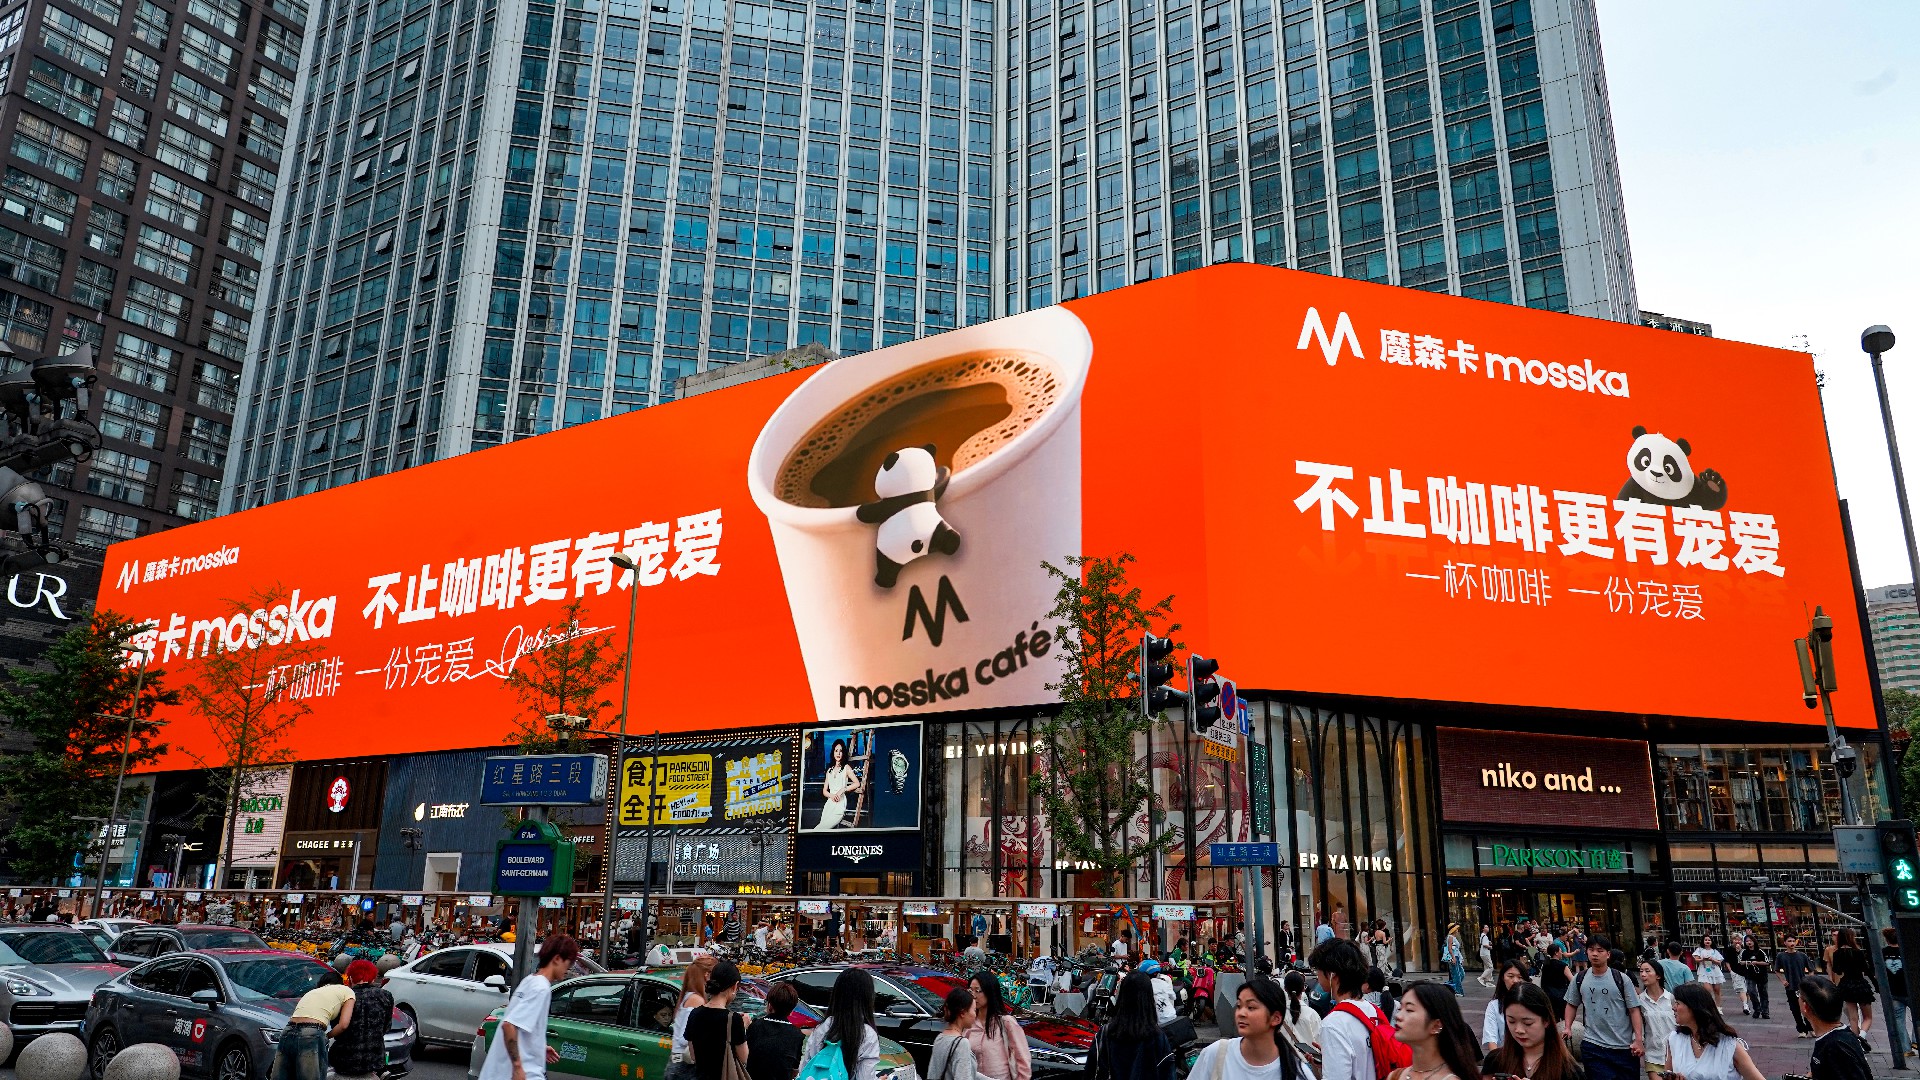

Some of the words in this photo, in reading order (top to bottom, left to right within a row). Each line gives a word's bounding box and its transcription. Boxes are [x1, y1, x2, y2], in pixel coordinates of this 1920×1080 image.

[1380, 328, 1479, 375] 魔森卡
[1485, 351, 1630, 398] mosska
[1293, 460, 1786, 577] 不止咖啡更有宠爱
[143, 556, 181, 583] 魔森卡
[180, 545, 240, 576] mosska
[362, 508, 723, 629] 不止咖啡更有宠爱
[7, 572, 72, 620] UR
[1405, 559, 1552, 607] 一杯咖啡
[1568, 576, 1706, 621] 一份宠爱
[186, 588, 337, 660] mosska
[241, 655, 344, 703] 一杯咖啡
[355, 636, 476, 690] 一份宠爱
[839, 667, 970, 710] mosska
[975, 620, 1052, 686] café
[493, 762, 581, 785] 红星路三段
[627, 761, 668, 788] 食力
[669, 761, 710, 773] PARKSON
[687, 773, 709, 782] STREET
[1482, 762, 1537, 789] niko
[1544, 767, 1593, 792] and
[624, 795, 666, 821] 全开
[296, 840, 330, 849] CHAGEE
[565, 835, 595, 844] OFFEE
[831, 844, 884, 857] LONGINES
[507, 856, 545, 864] BOULEVARD
[692, 864, 720, 874] STREET
[1055, 860, 1070, 870] EP
[1300, 853, 1319, 868] EP
[1329, 854, 1392, 871] YAYING
[1491, 844, 1585, 868] PARKSON
[1588, 849, 1622, 870] 百盛
[501, 868, 549, 877] SAINT-GERMAIN
[1907, 890, 1919, 906] 5
[173, 1017, 193, 1037] 滴滴
